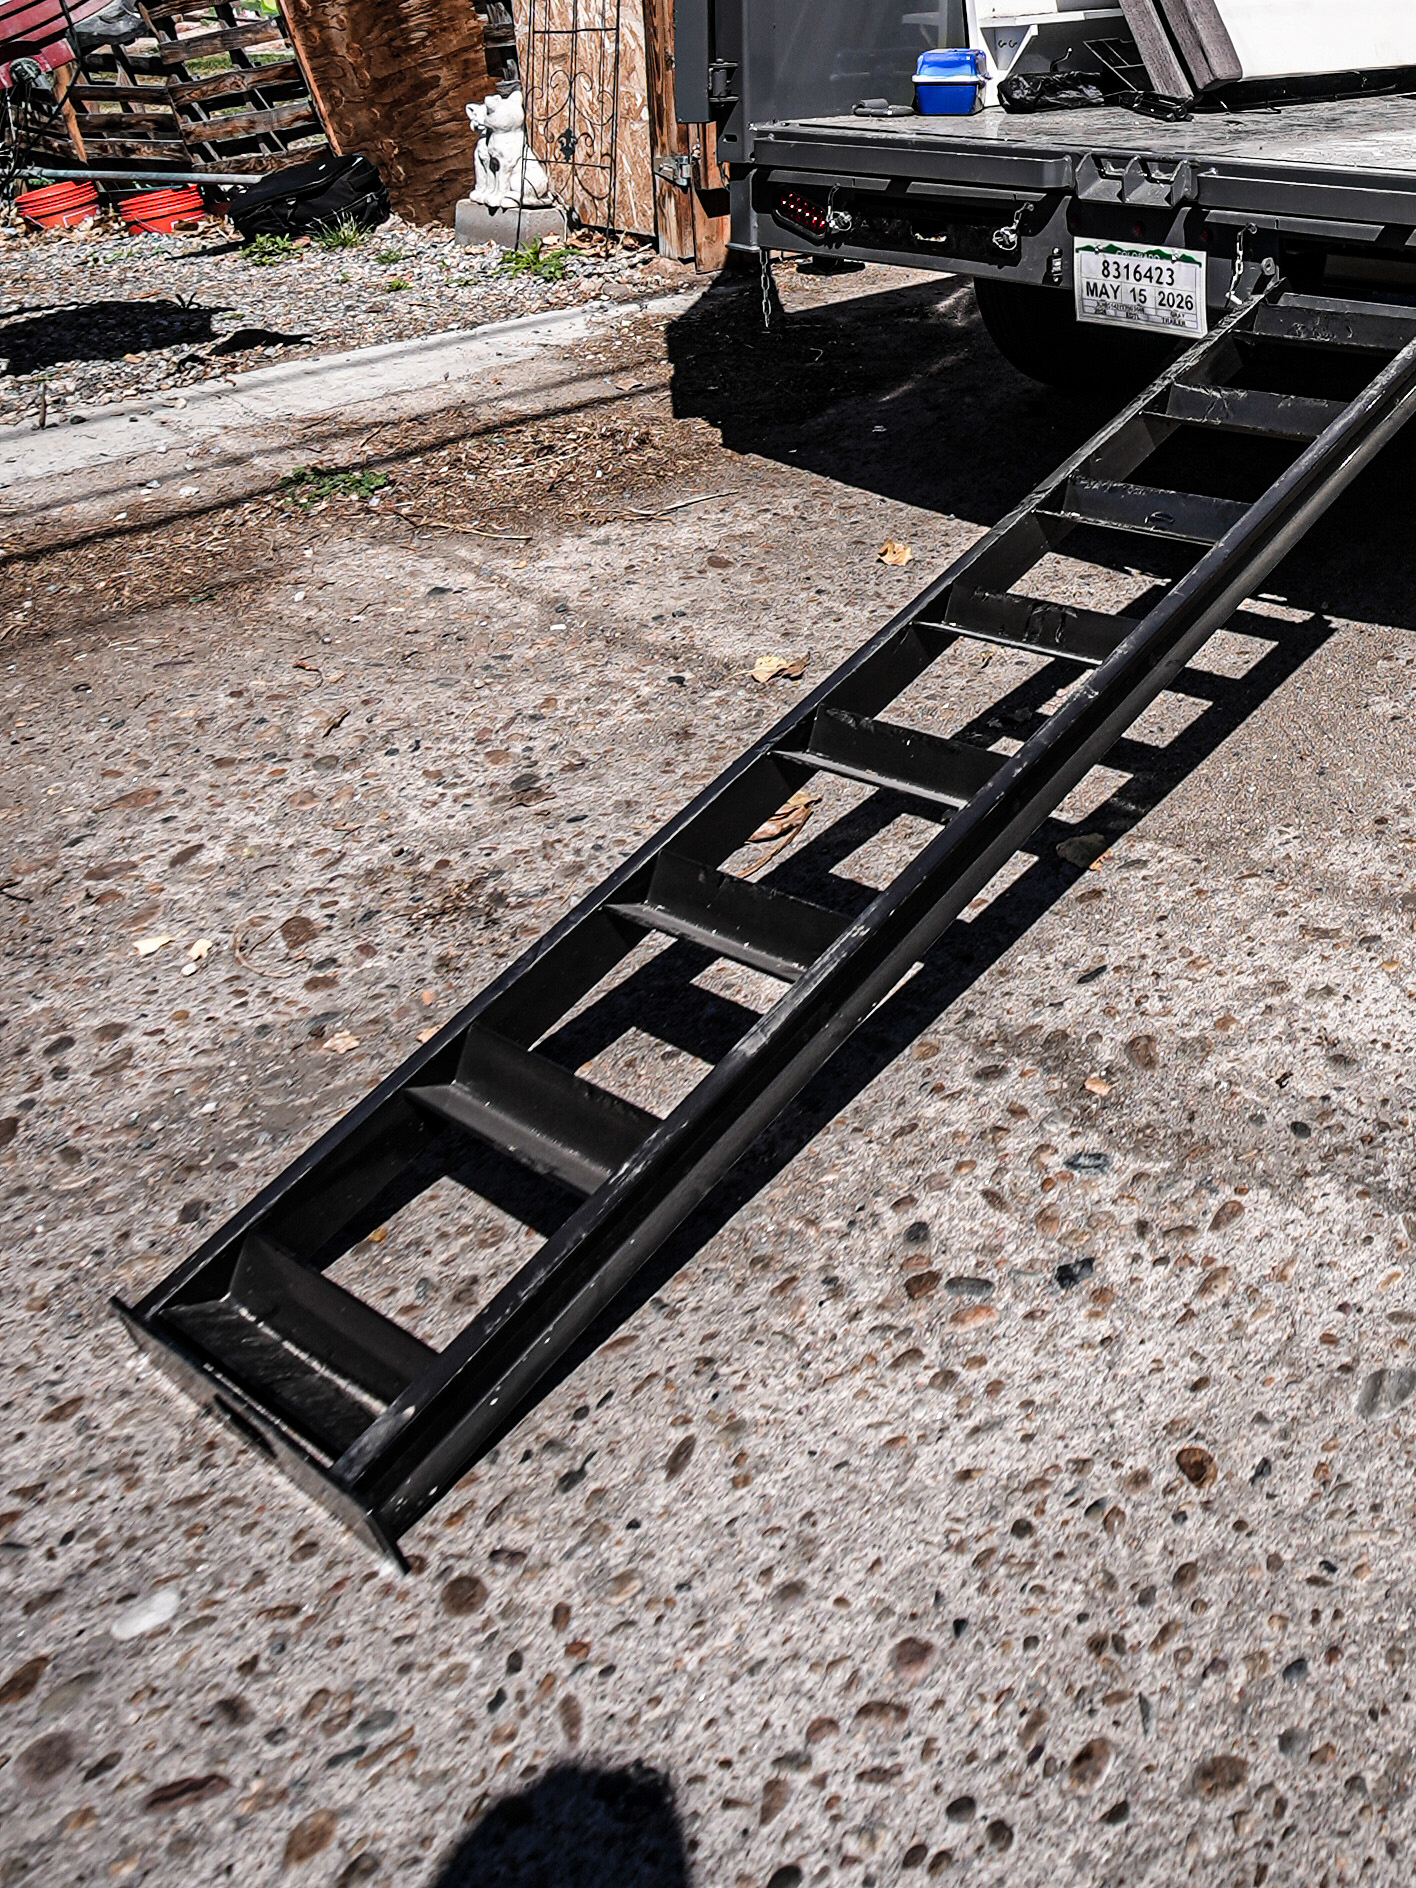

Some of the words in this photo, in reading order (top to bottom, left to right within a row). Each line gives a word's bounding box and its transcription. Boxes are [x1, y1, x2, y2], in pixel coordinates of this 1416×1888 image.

[1101, 259, 1175, 286] 8316423
[1086, 281, 1121, 300] MAY
[1129, 287, 1147, 304] 15
[1158, 290, 1194, 311] 2026
